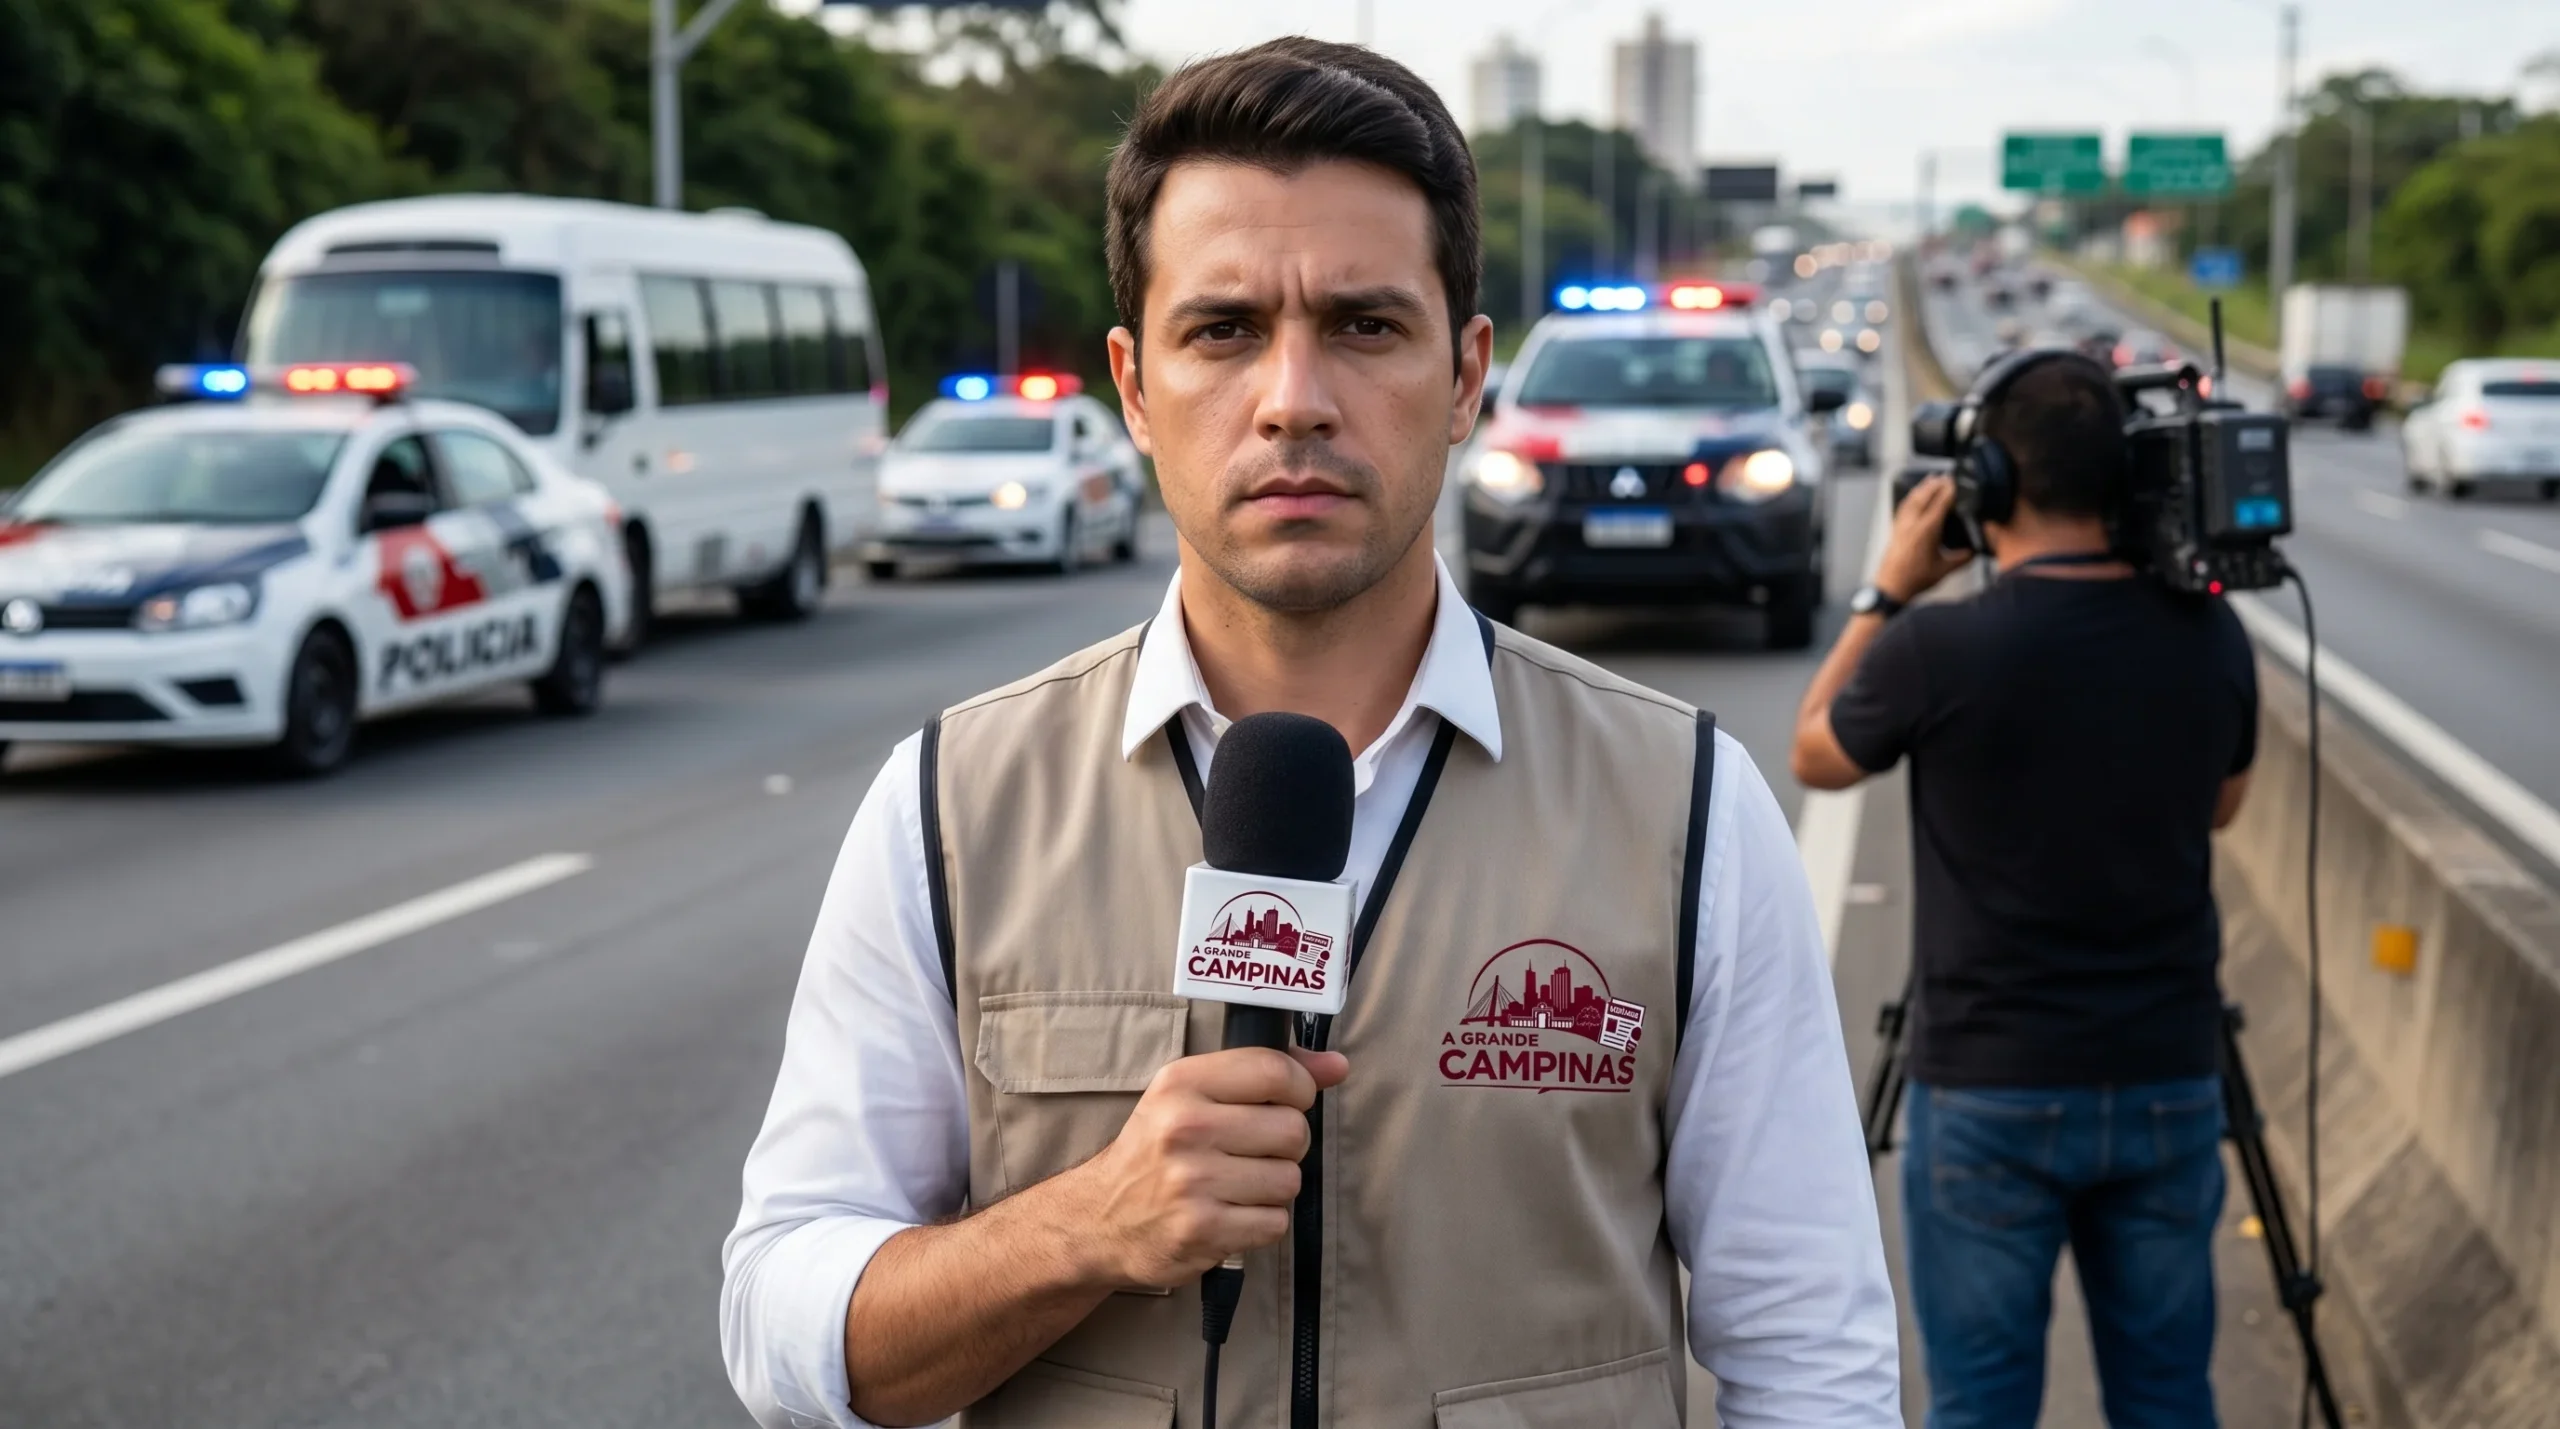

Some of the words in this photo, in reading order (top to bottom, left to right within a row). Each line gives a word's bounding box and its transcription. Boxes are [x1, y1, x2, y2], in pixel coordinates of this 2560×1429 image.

[1192, 945, 1200, 954] A
[1204, 946, 1251, 959] GRANDE
[1188, 955, 1326, 991] CAMPINAS
[1441, 1032, 1456, 1046] A
[1461, 1032, 1539, 1047] GRANDE
[1439, 1049, 1636, 1085] CAMPINAS
